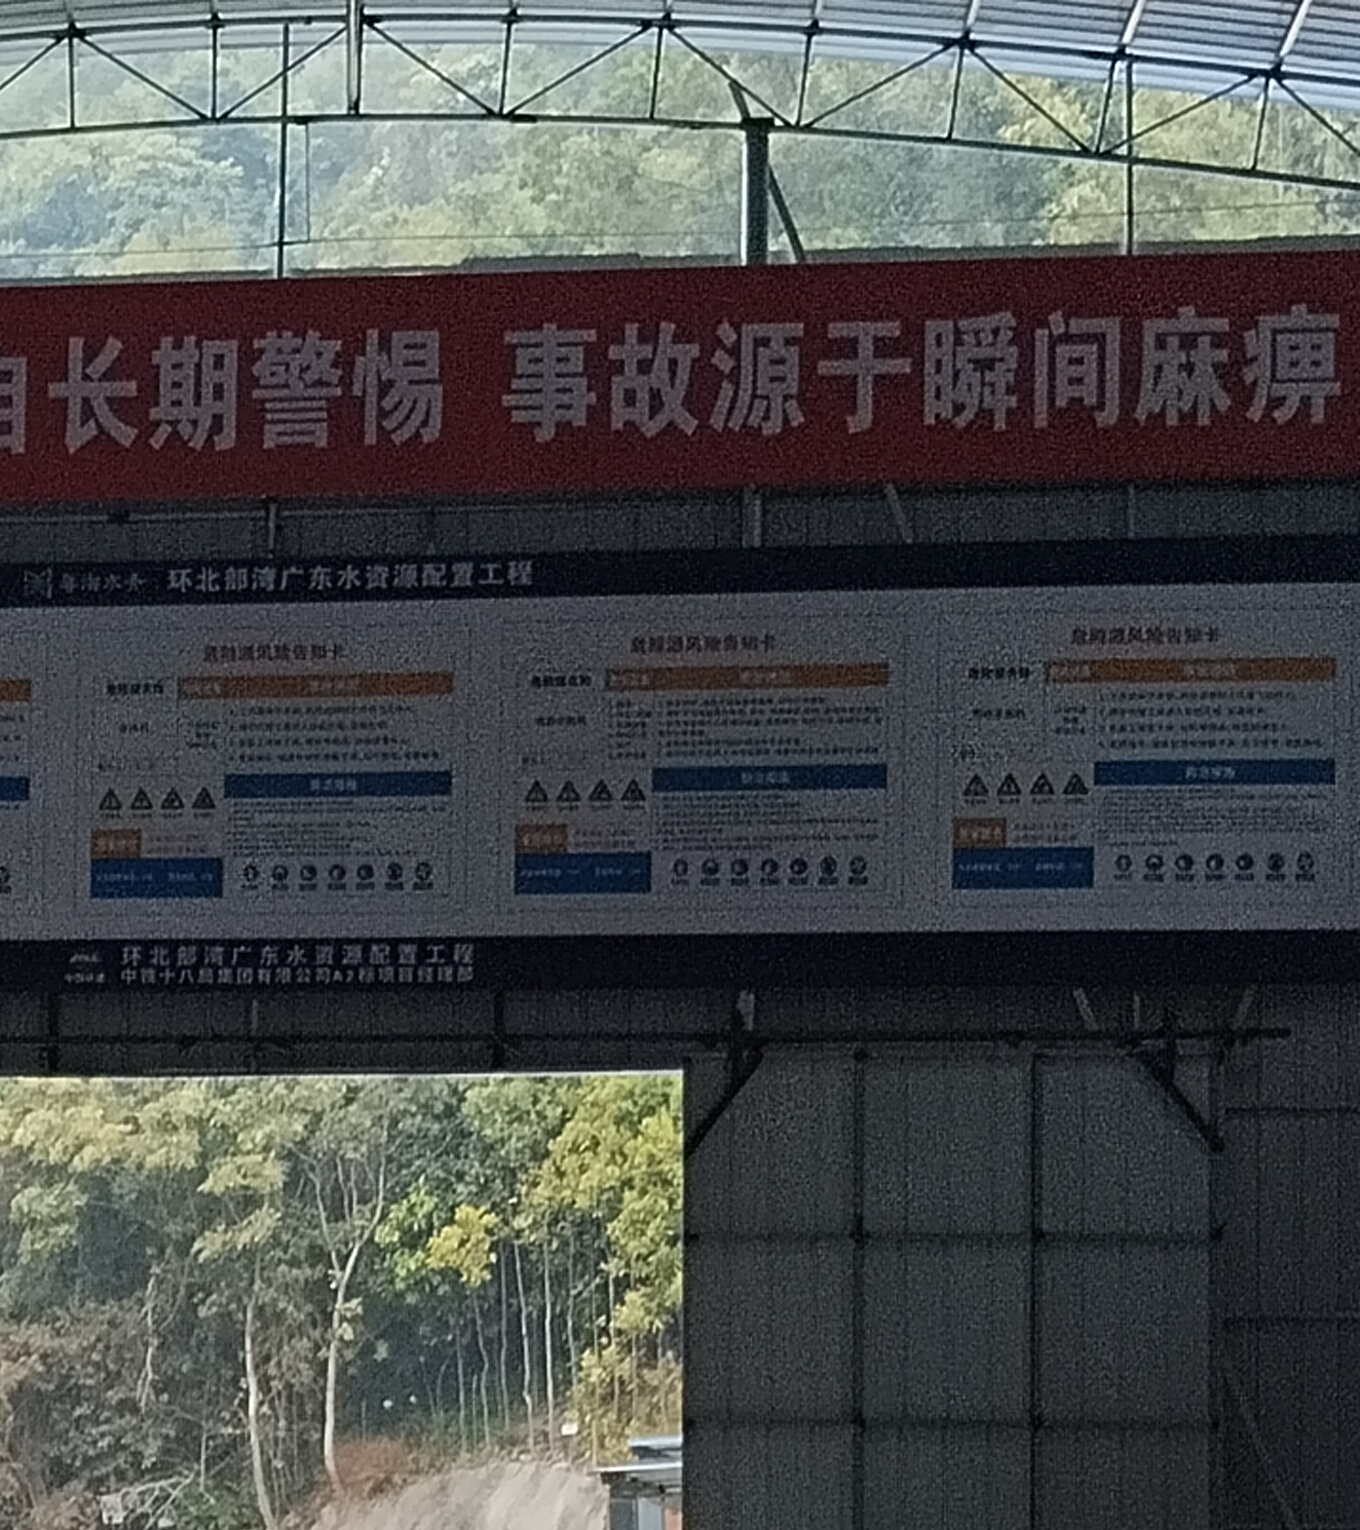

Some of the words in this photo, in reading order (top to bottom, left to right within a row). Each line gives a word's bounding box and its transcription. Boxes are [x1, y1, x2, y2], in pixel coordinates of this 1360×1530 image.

[503, 305, 1342, 444] 事故源于瞬间麻痹
[166, 560, 534, 593] 环北部湾广东水资源配置工程
[121, 944, 475, 966] 环北部湾广东水资源配置工程
